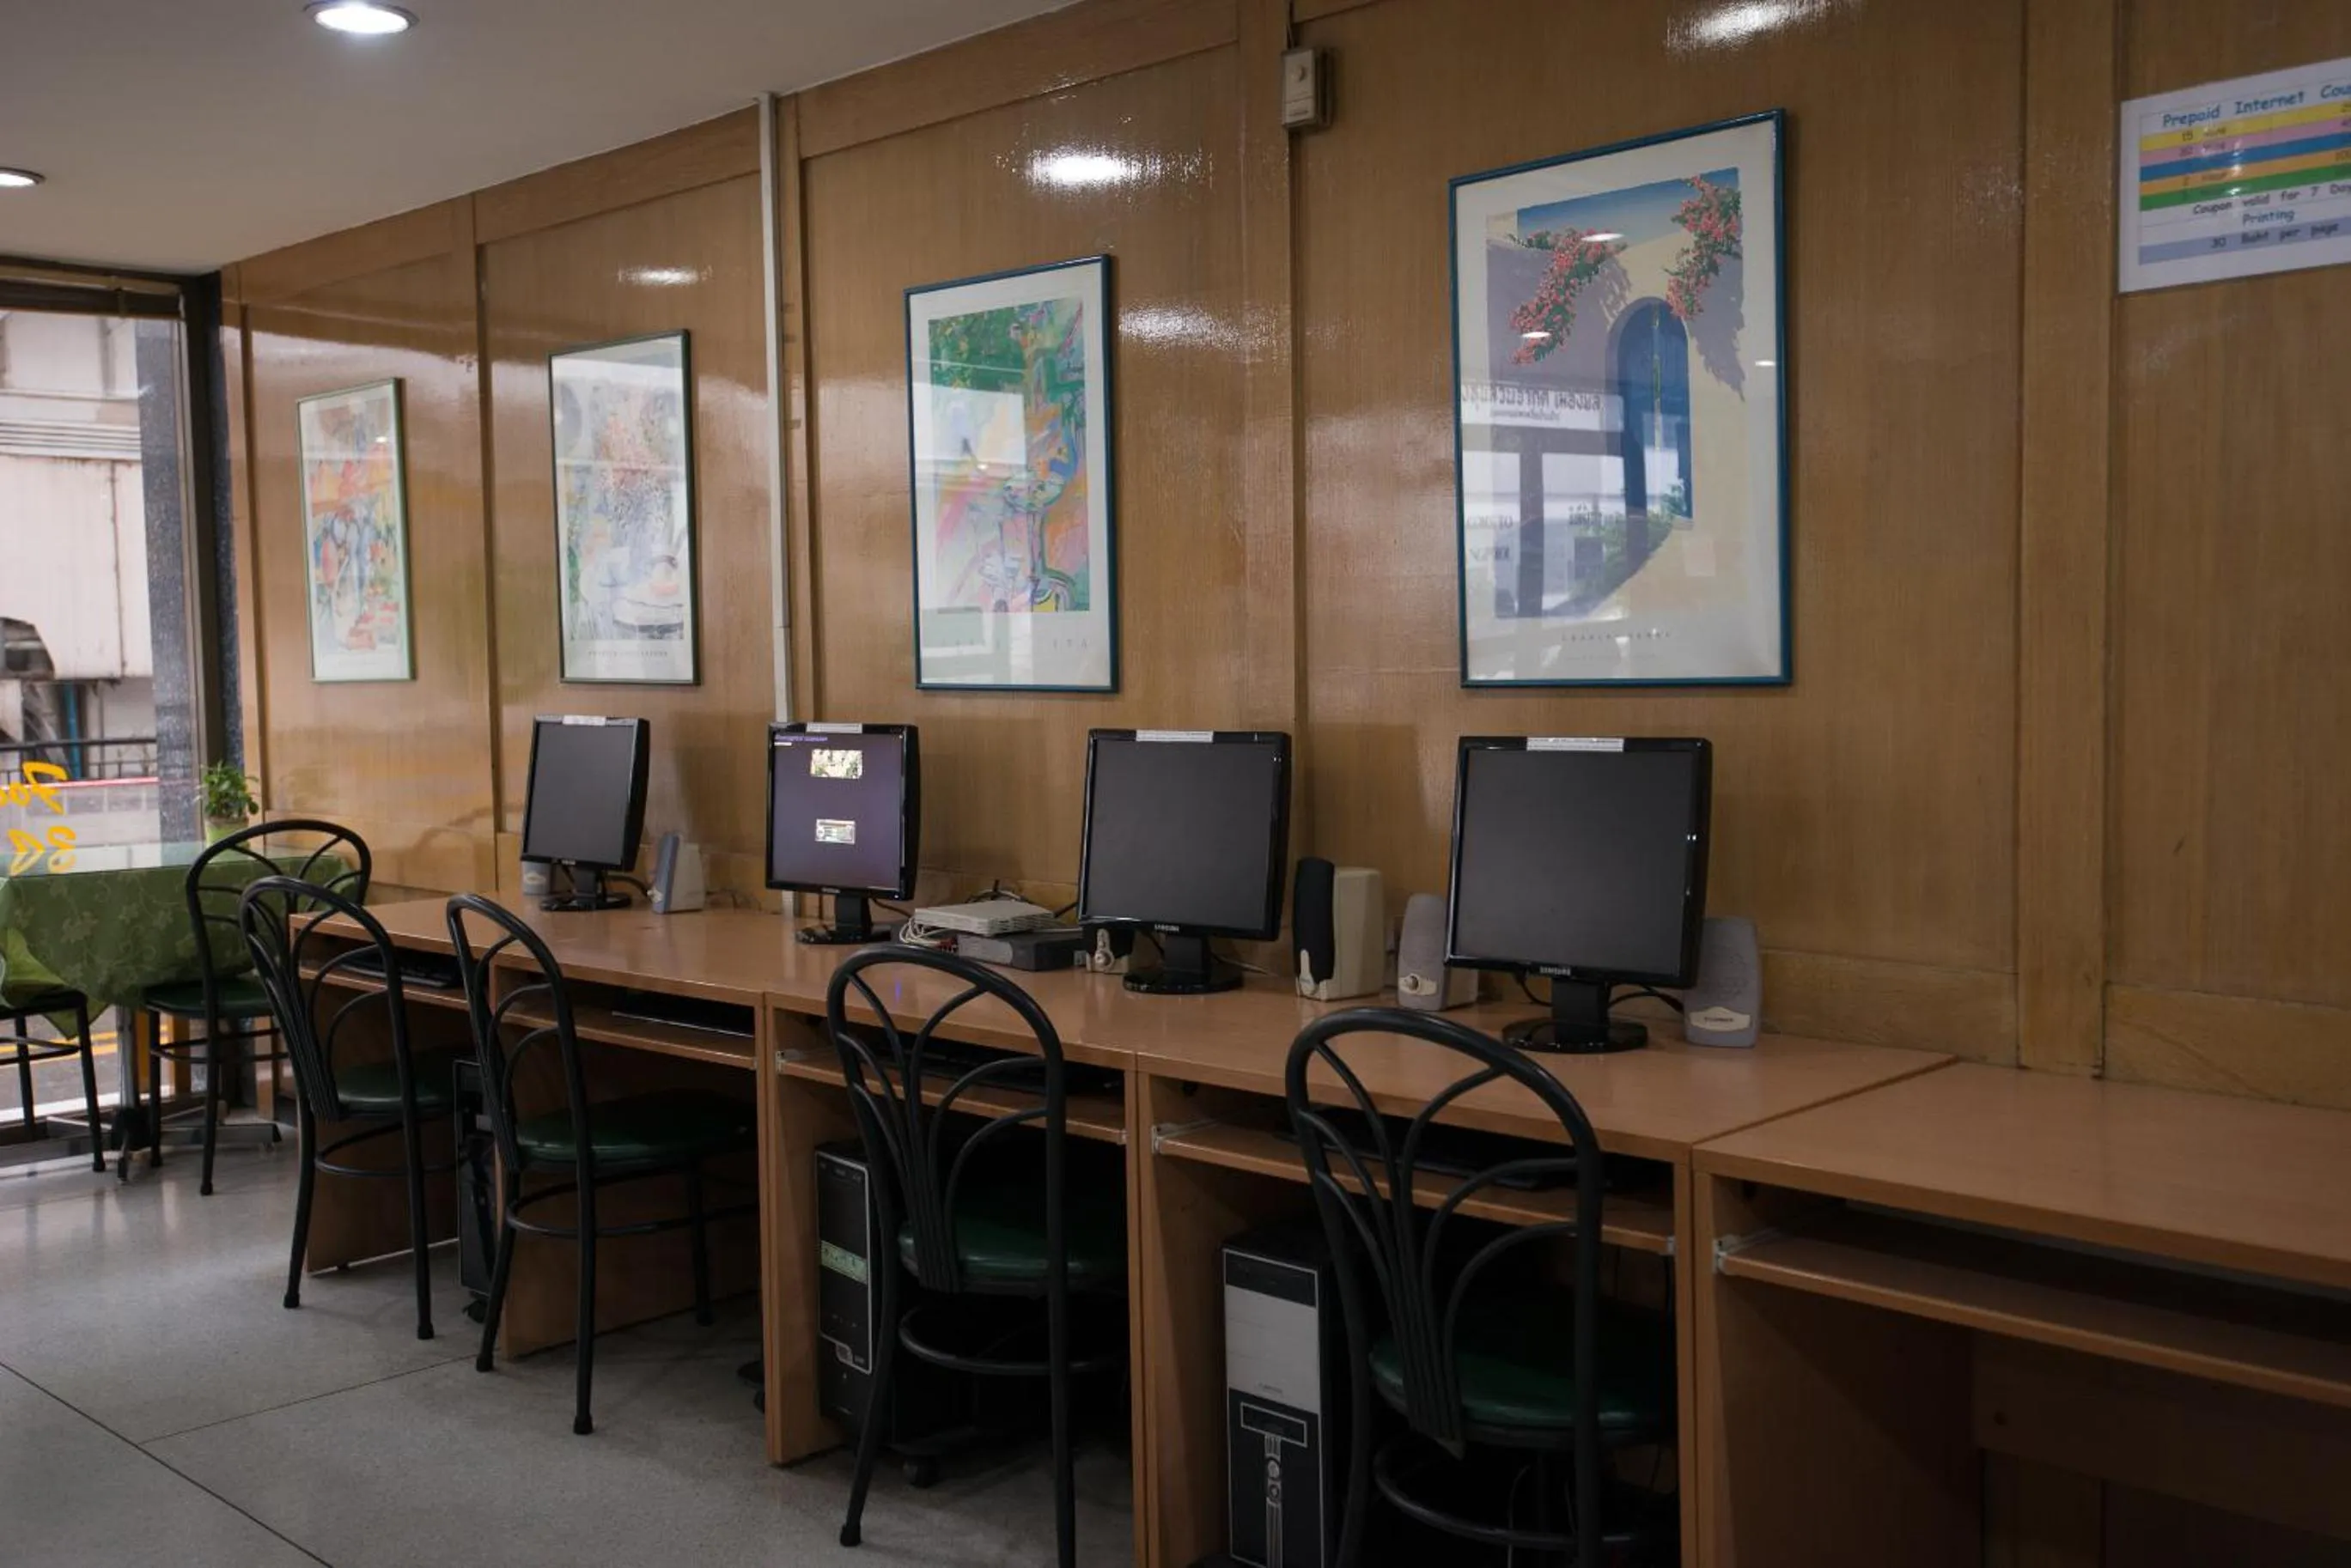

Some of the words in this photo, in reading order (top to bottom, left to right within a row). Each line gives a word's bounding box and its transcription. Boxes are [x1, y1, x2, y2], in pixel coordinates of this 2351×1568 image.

[2162, 105, 2220, 128] Prepaid
[2235, 90, 2305, 115] Internet
[2192, 200, 2233, 216] Coupon
[2242, 193, 2270, 208] valid
[2281, 191, 2300, 201] for
[2242, 209, 2295, 226] Printing
[2279, 228, 2301, 241] per
